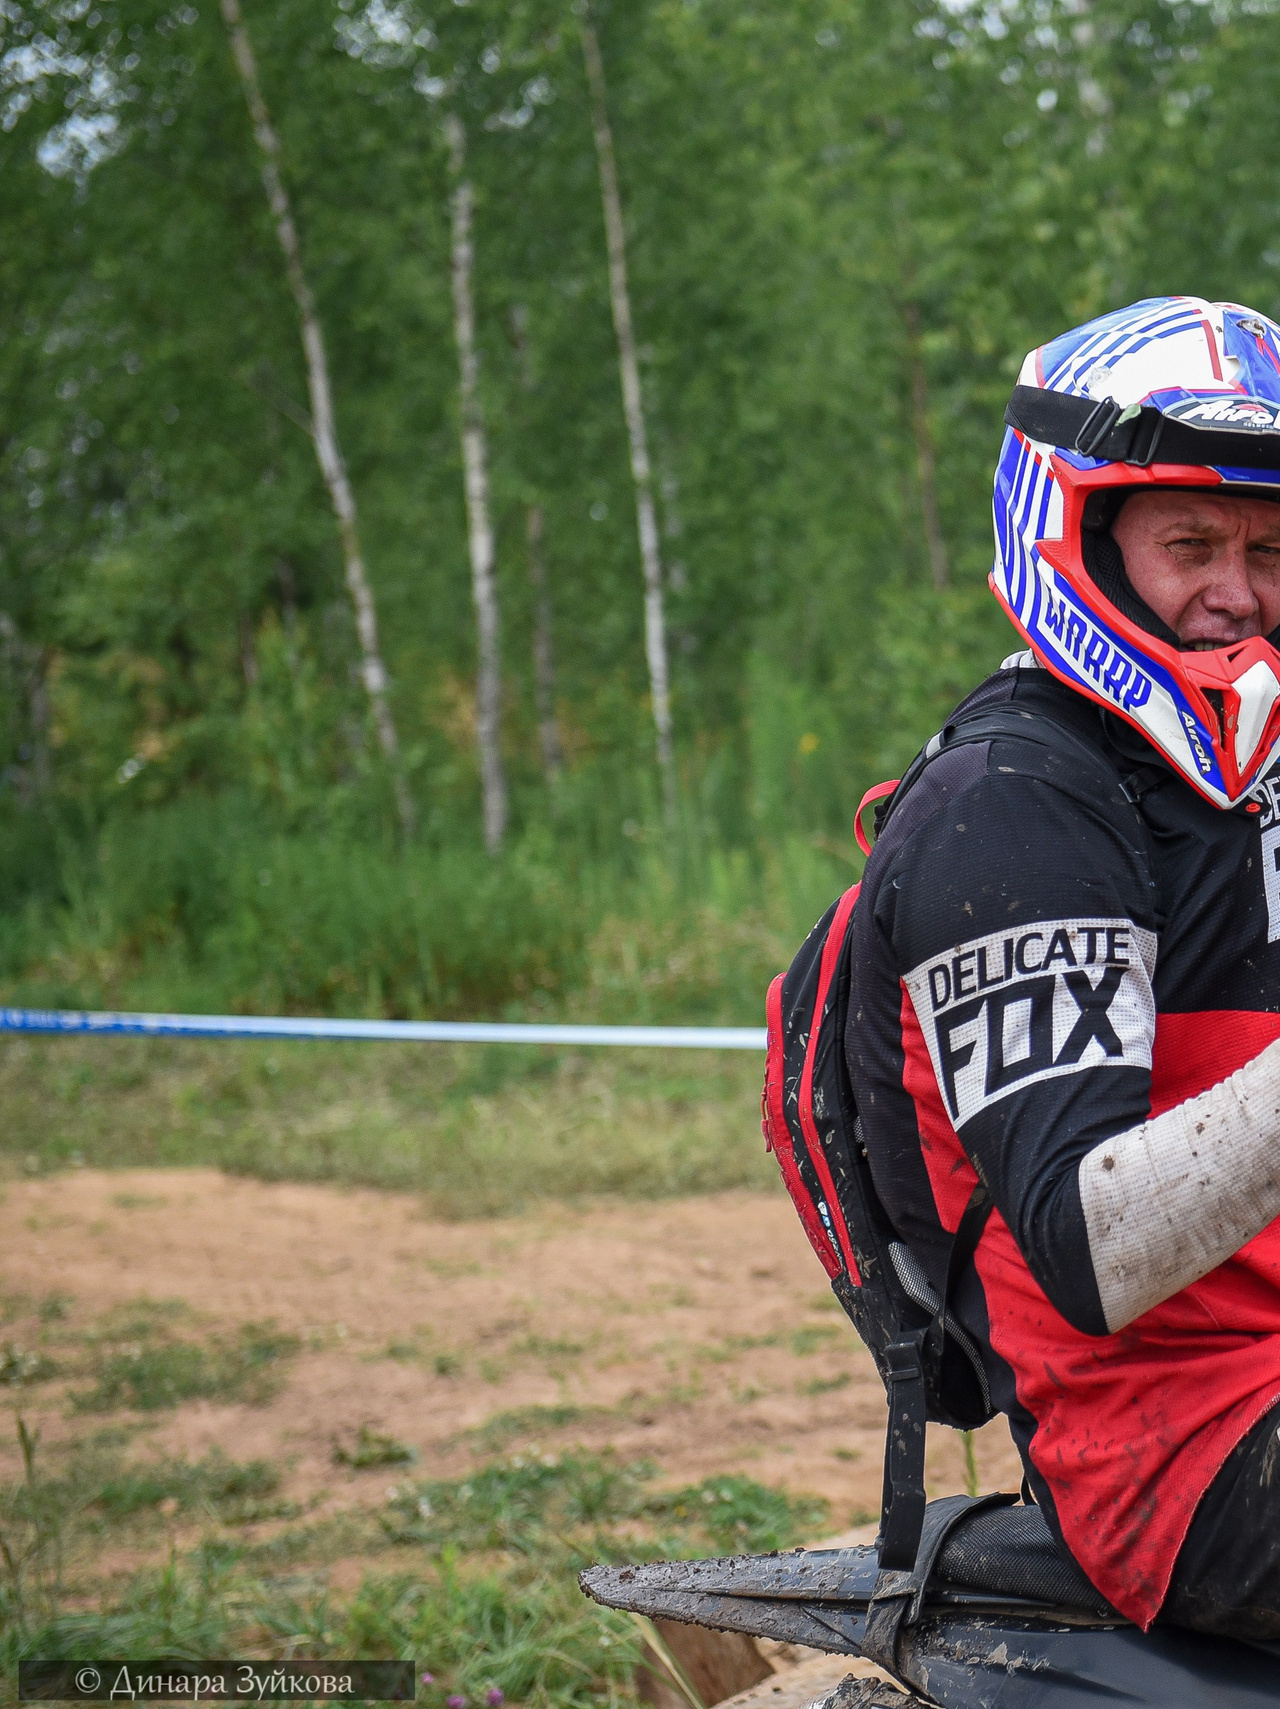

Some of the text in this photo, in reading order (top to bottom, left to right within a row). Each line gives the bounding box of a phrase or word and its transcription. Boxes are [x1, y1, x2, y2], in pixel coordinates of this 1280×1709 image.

[1181, 710, 1212, 774] Airoh
[928, 927, 1130, 1012] DELICATE
[934, 967, 1130, 1121] FOX
